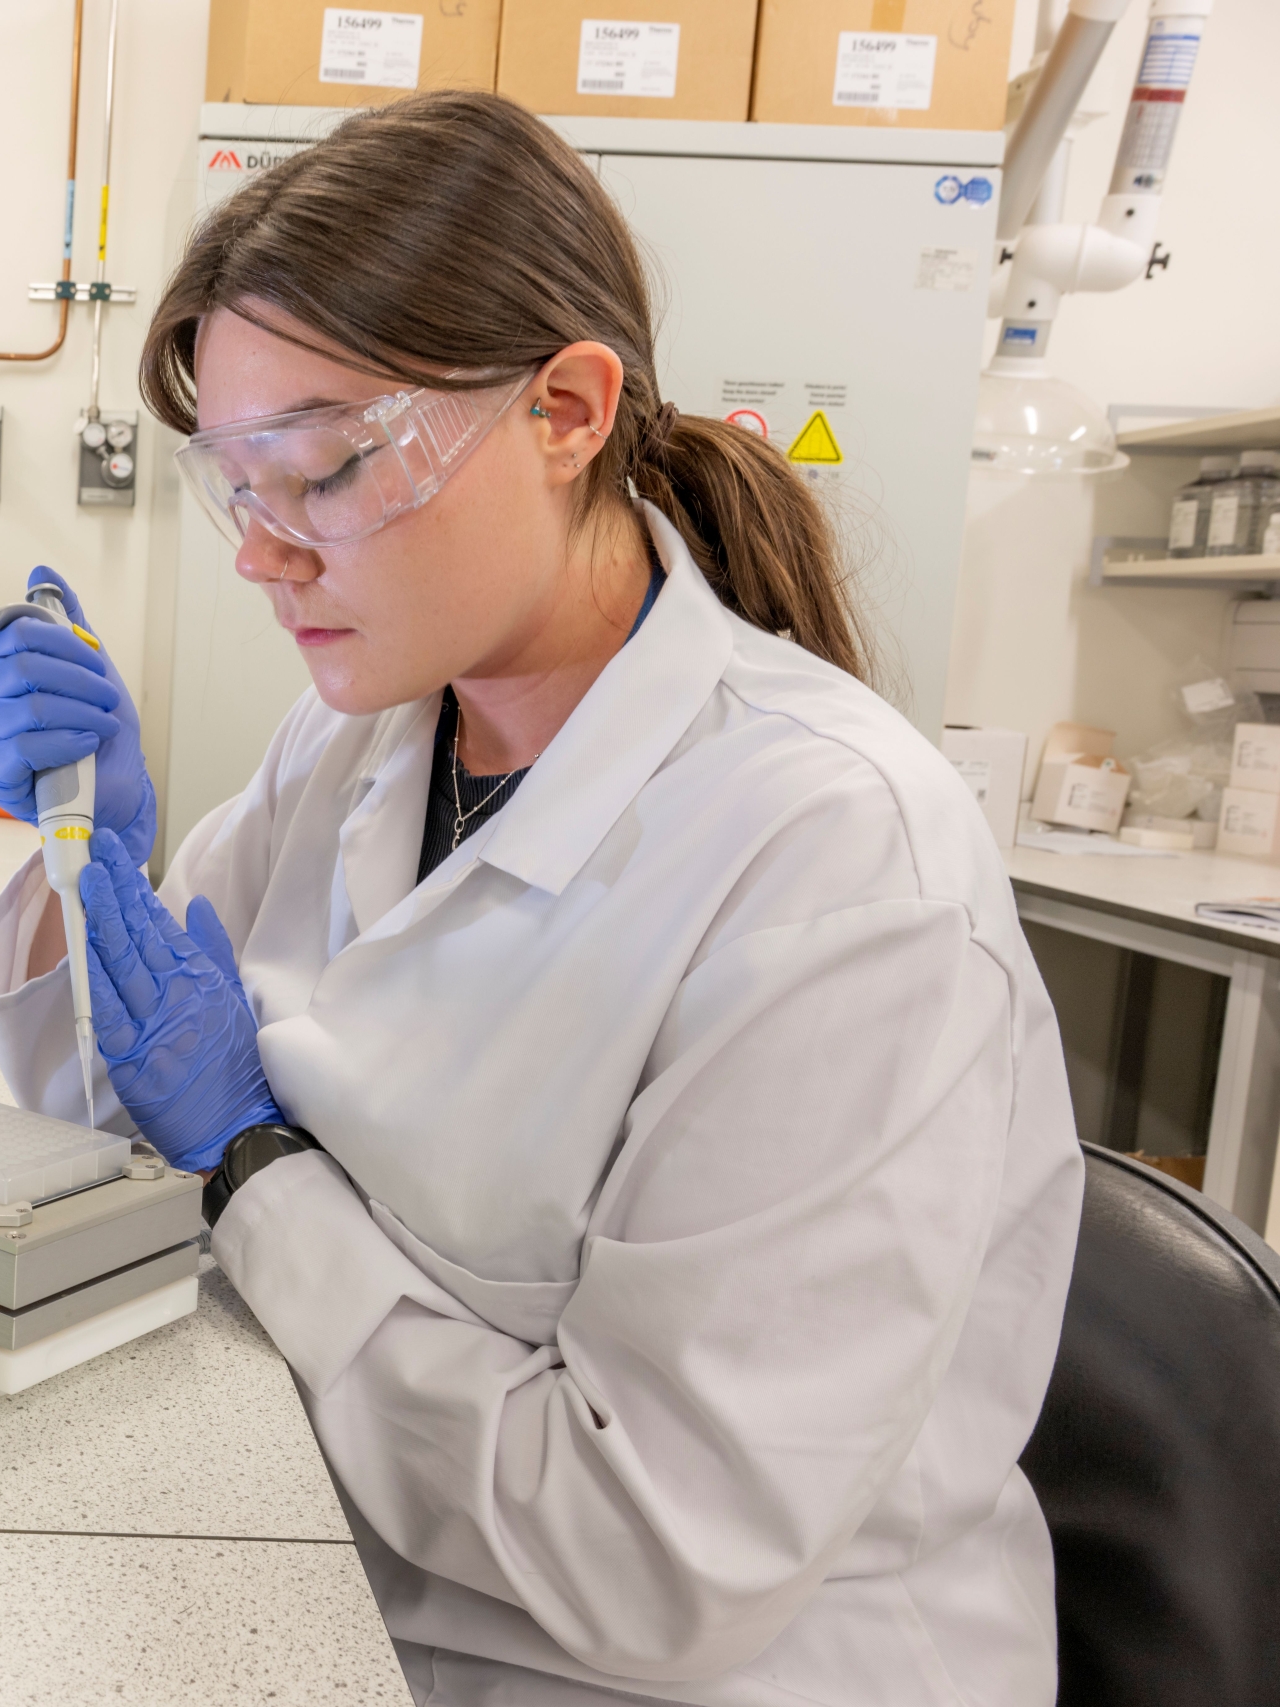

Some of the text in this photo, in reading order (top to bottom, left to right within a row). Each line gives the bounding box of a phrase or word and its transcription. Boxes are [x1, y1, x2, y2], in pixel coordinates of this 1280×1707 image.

[337, 16, 382, 31] 156499
[594, 27, 640, 40] 156499
[852, 39, 896, 53] 156499
